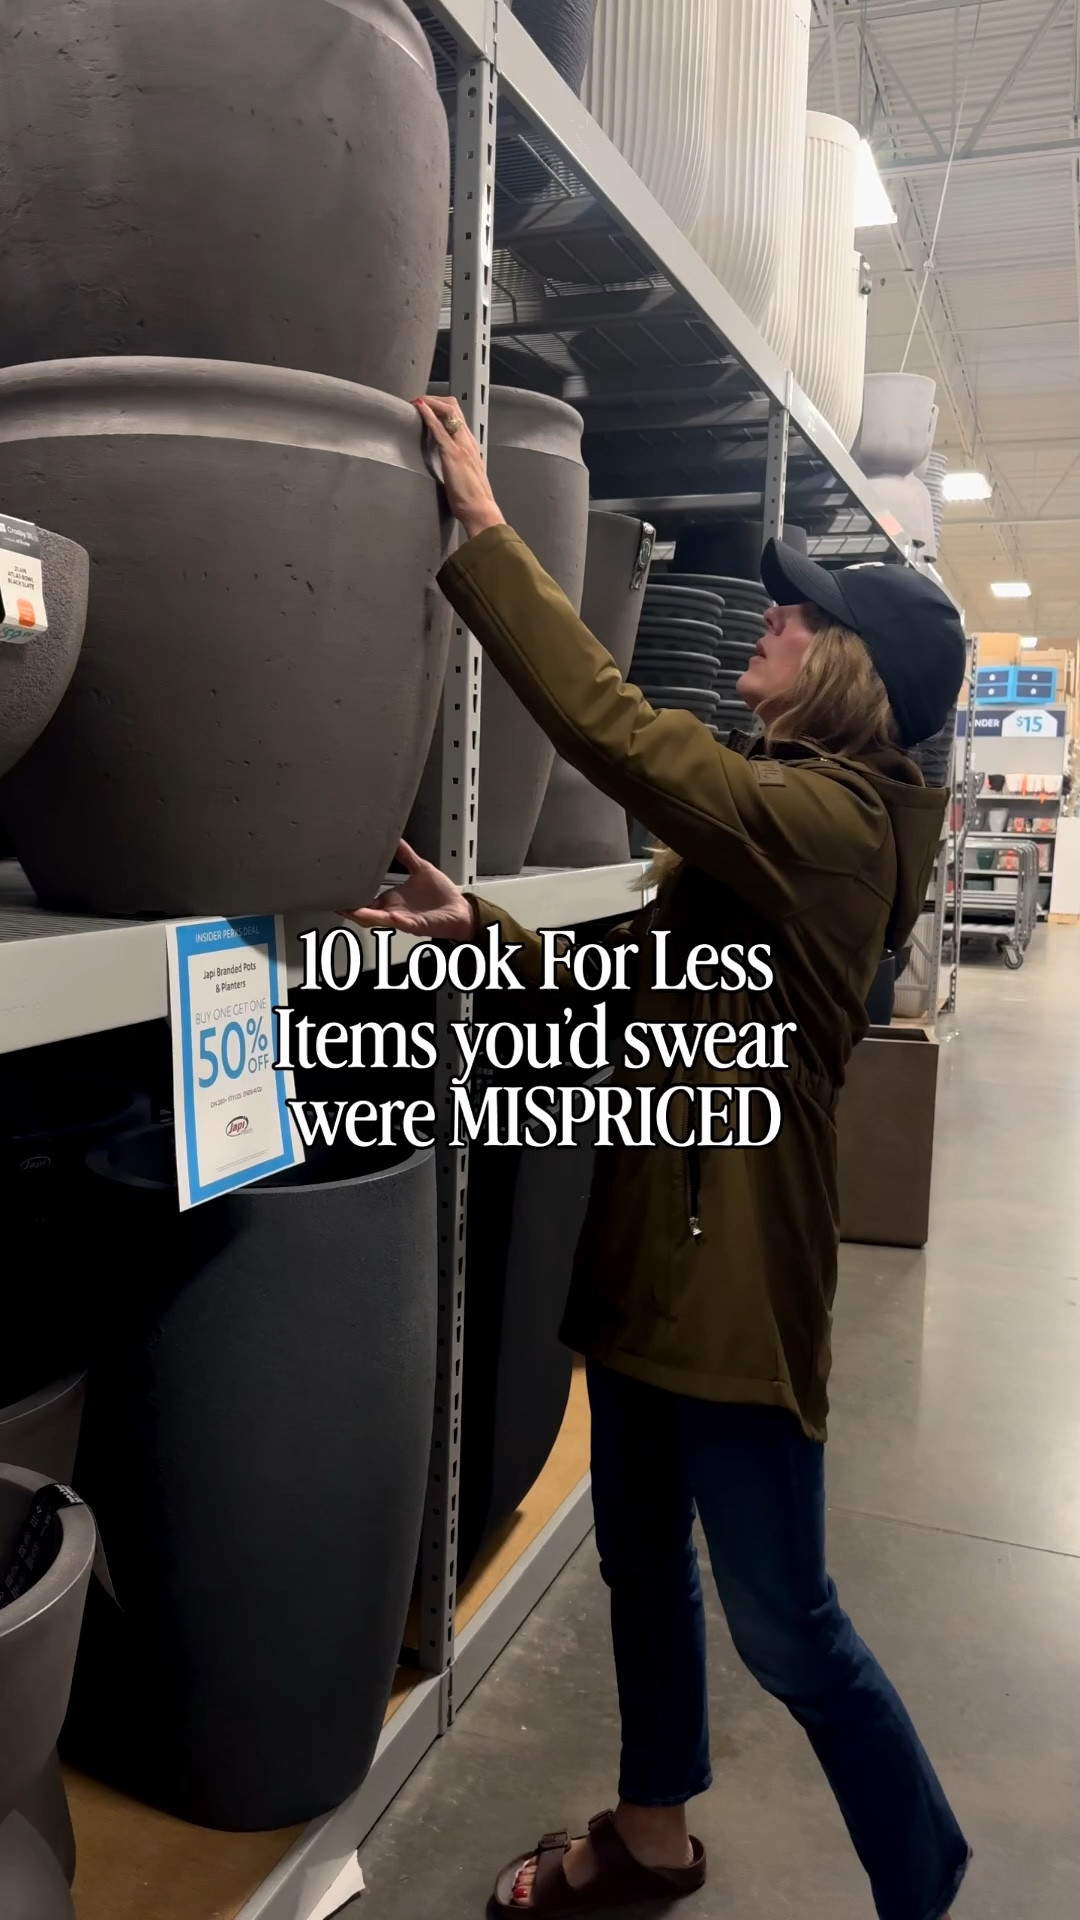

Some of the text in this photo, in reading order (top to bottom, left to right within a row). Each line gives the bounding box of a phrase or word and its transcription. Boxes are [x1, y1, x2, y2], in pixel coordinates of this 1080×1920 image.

[1016, 716, 1043, 733] $15
[195, 925, 260, 944] INSIDER PERKS DEAL
[203, 961, 257, 980] Japi Branded Pots
[215, 980, 247, 993] & Planters
[195, 998, 267, 1025] BUY ONE GET ONE
[198, 1015, 268, 1089] 50%
[248, 1054, 269, 1074] OFF
